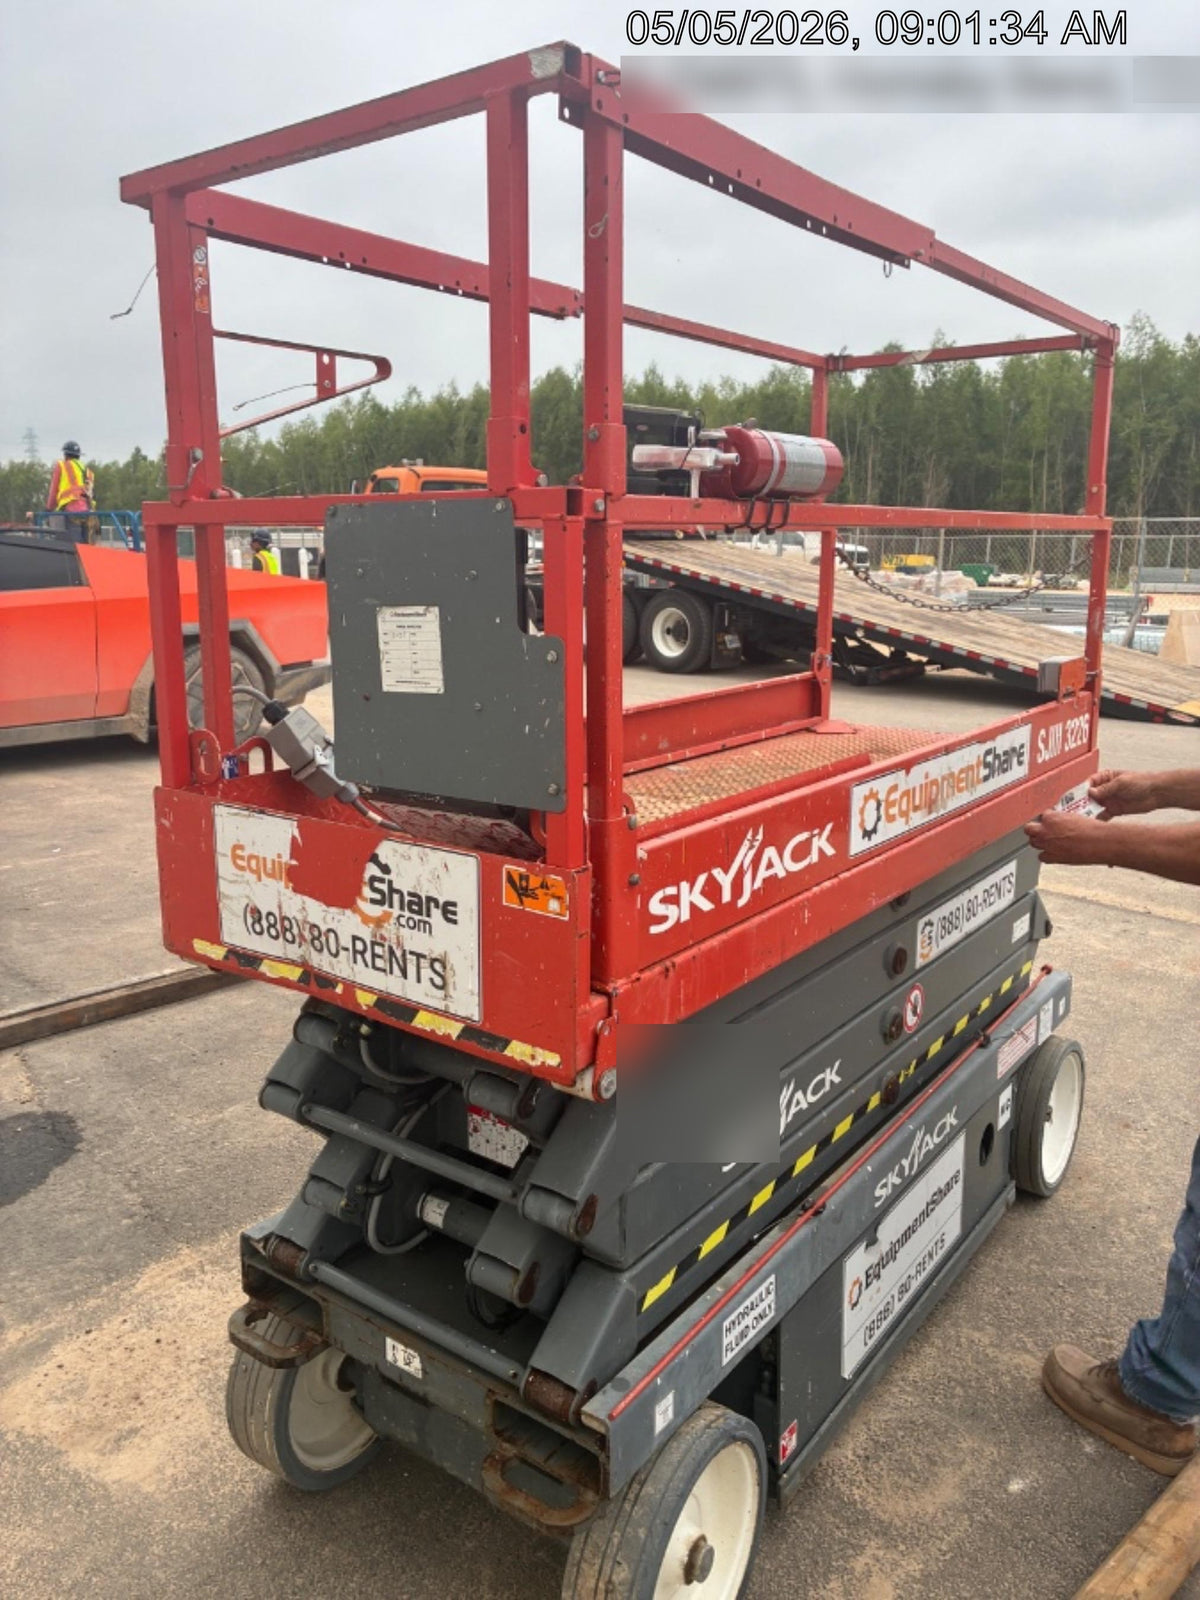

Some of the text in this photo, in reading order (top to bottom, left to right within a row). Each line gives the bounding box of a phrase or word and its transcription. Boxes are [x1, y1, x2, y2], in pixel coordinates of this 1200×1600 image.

[1064, 713, 1090, 752] 3226
[884, 743, 1026, 826] EquipmentShare
[648, 822, 837, 934] SKYJACK
[936, 903, 965, 948] (888)
[965, 872, 1015, 923] 80-RENTS
[243, 902, 448, 991] (888) 80-RENTS
[393, 913, 433, 936] .com
[874, 1105, 960, 1207] SKYJACK
[864, 1168, 961, 1291] EquipmentShare
[725, 1281, 774, 1338] HYDRAULIC
[725, 1301, 774, 1358] FLUID ONLY
